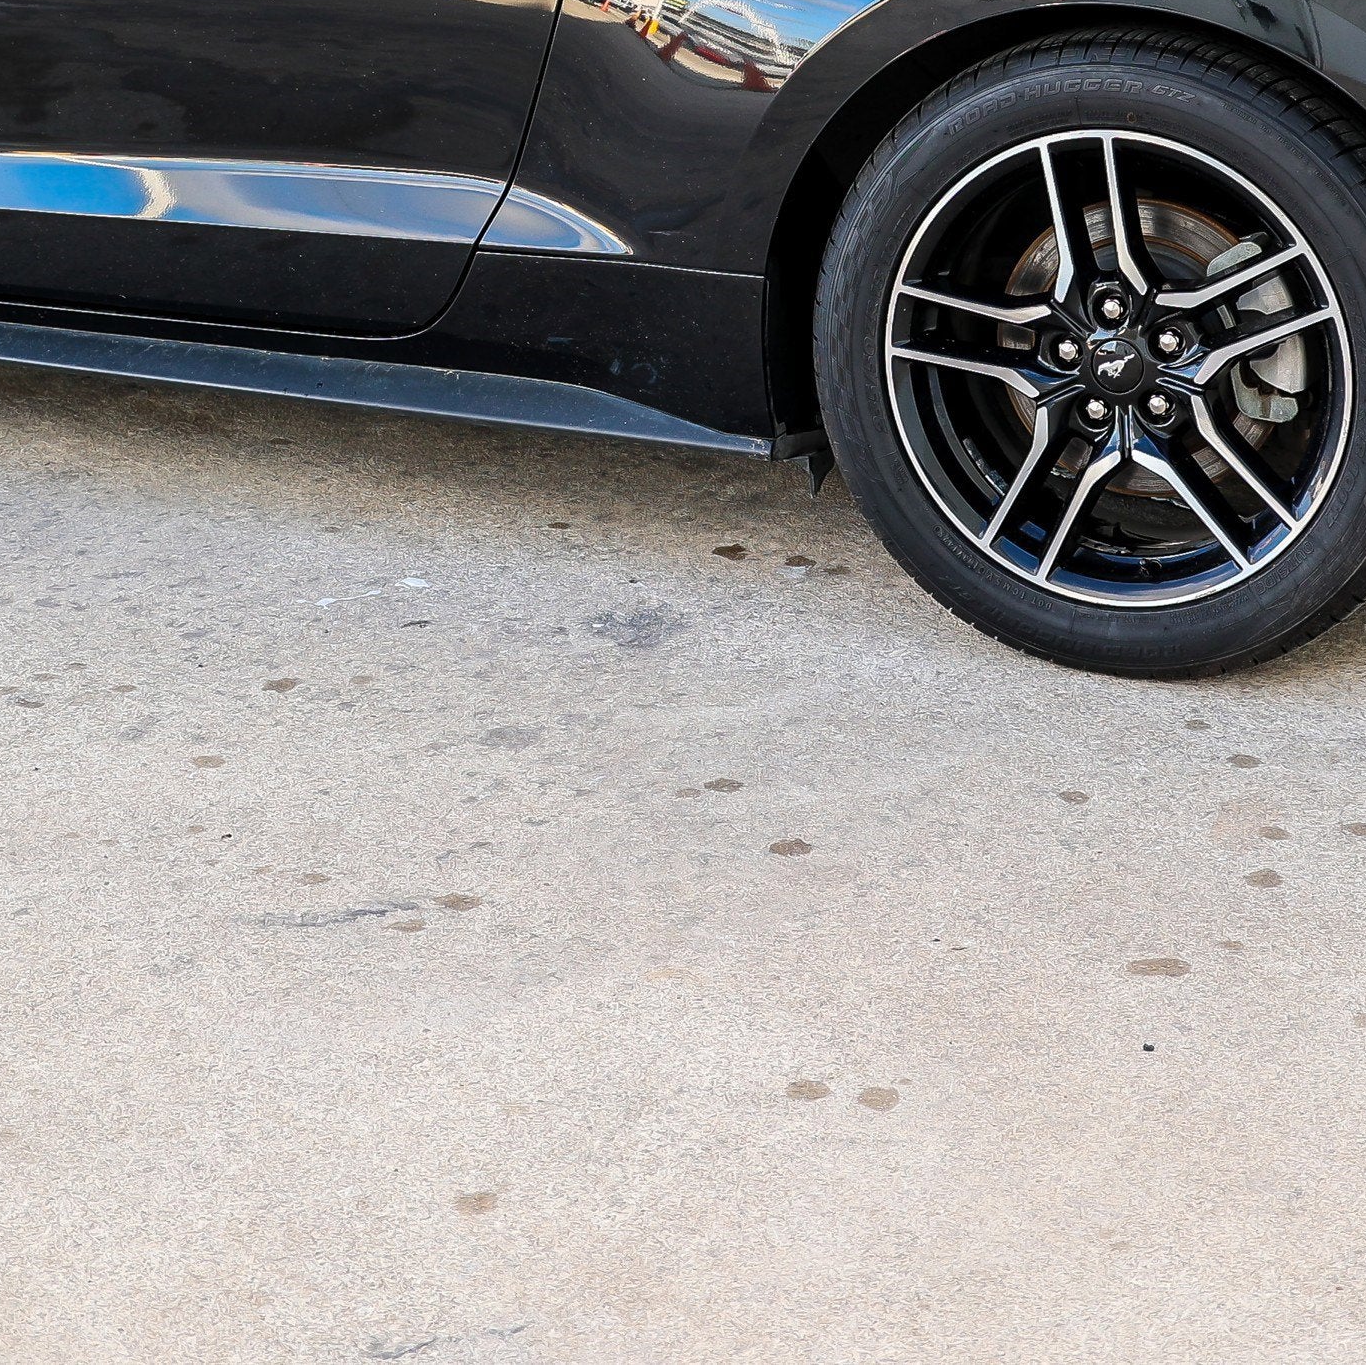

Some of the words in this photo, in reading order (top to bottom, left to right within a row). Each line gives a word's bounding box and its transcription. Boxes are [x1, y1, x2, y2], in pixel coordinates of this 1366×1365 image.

[948, 92, 1017, 134] ROAD
[1024, 78, 1143, 101] HUGGER
[1151, 84, 1197, 103] GTZ
